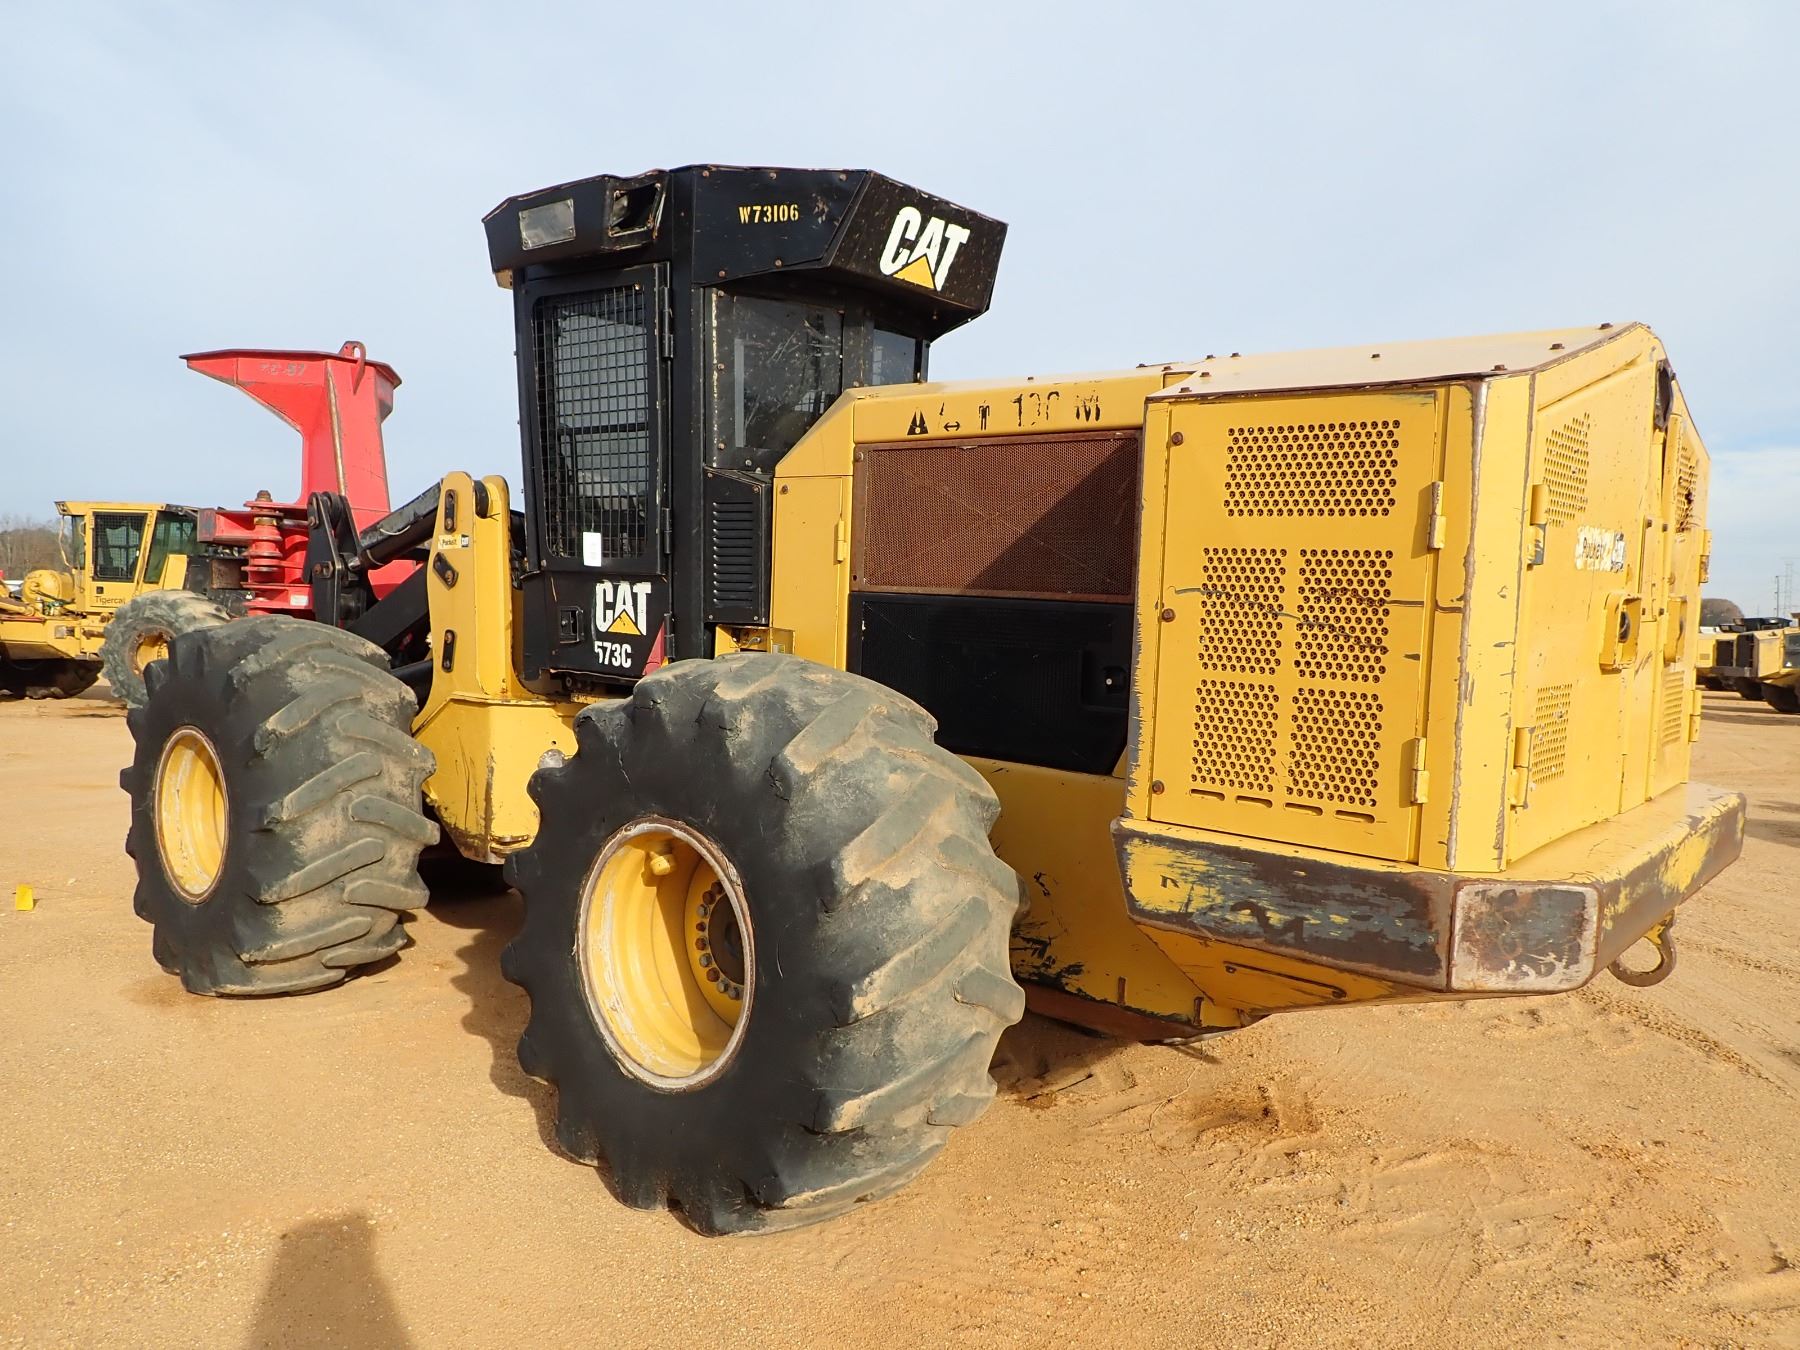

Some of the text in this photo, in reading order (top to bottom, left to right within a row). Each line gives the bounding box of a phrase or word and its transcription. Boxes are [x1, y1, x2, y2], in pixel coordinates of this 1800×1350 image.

[738, 204, 798, 225] W73106
[880, 206, 970, 291] CAT
[596, 579, 651, 635] CAT
[594, 641, 631, 668] 573C
